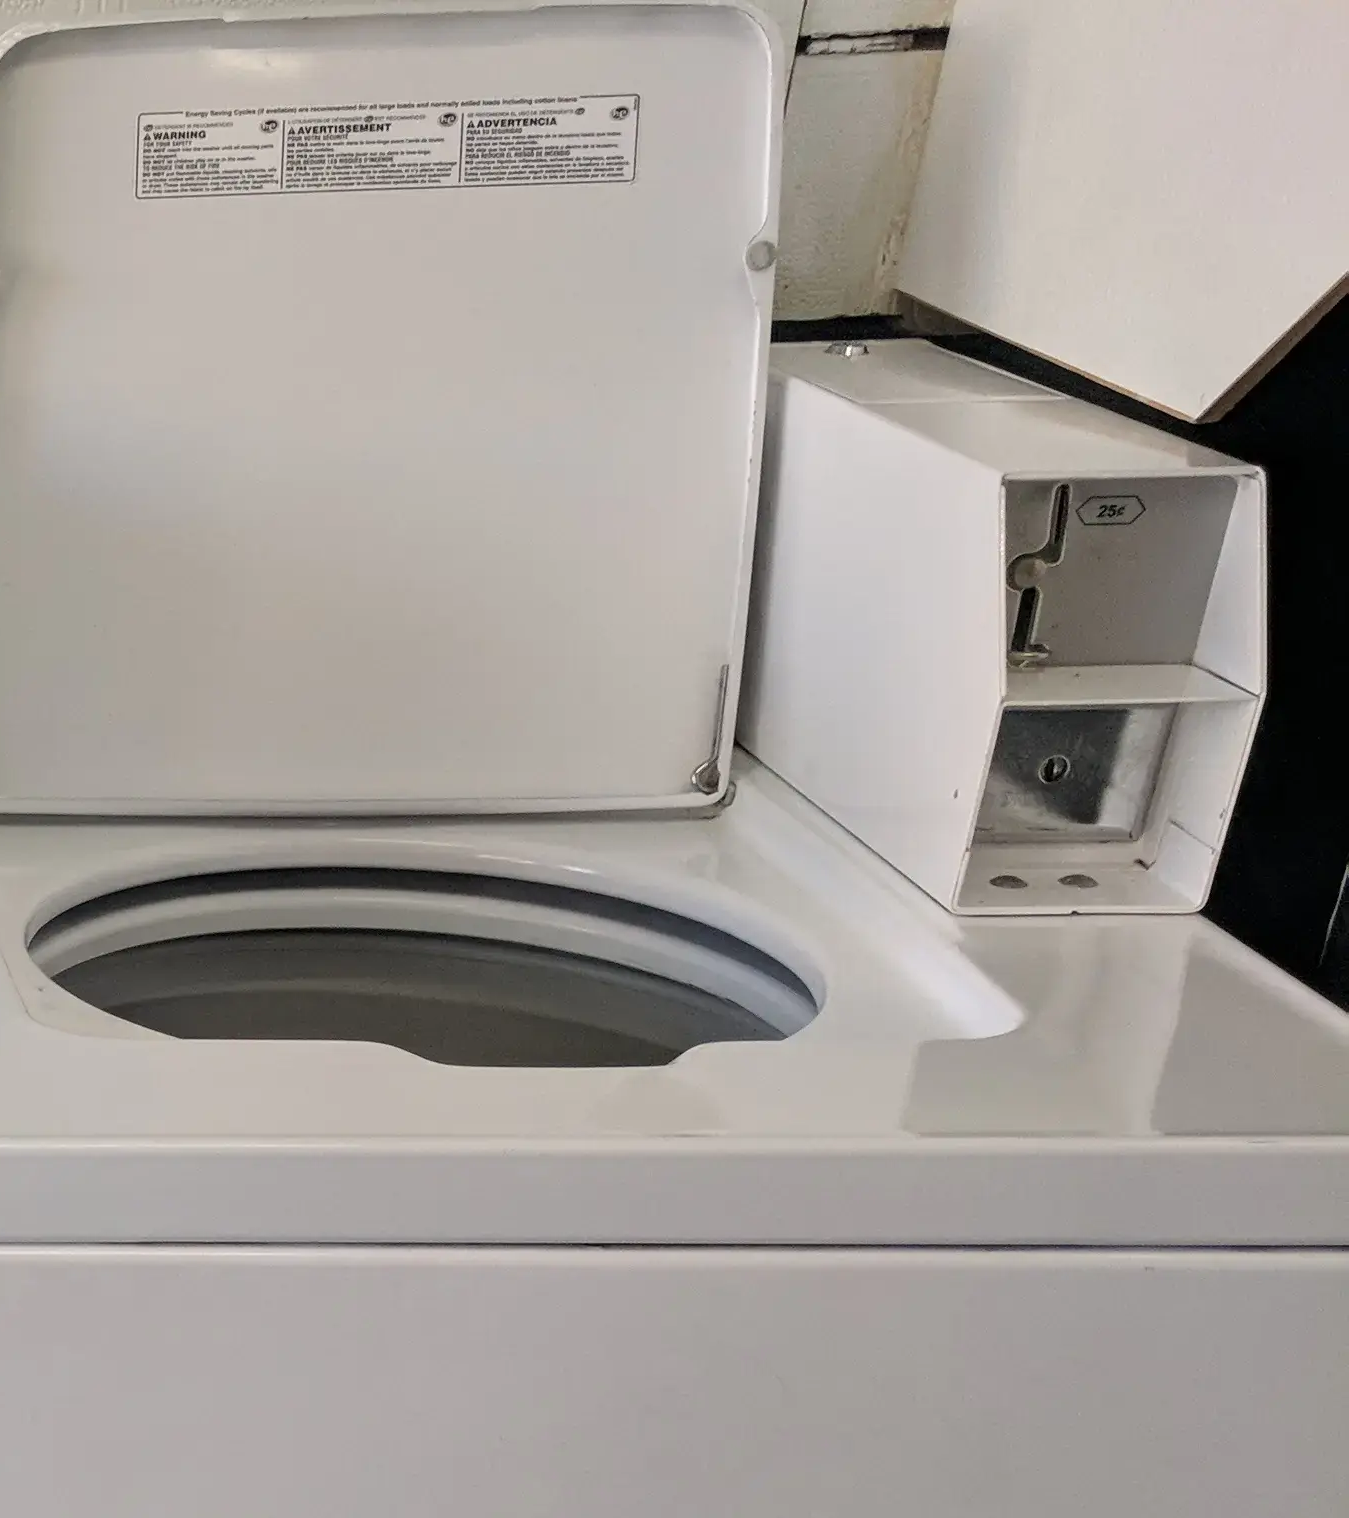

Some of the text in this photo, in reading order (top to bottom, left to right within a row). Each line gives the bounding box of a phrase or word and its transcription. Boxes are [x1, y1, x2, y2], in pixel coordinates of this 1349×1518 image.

[379, 103, 396, 111] large
[477, 117, 557, 128] ADVERTENCIA
[297, 123, 392, 134] AVERTISSEMENT
[153, 130, 207, 140] WARNING
[1096, 504, 1127, 518] 25¢
